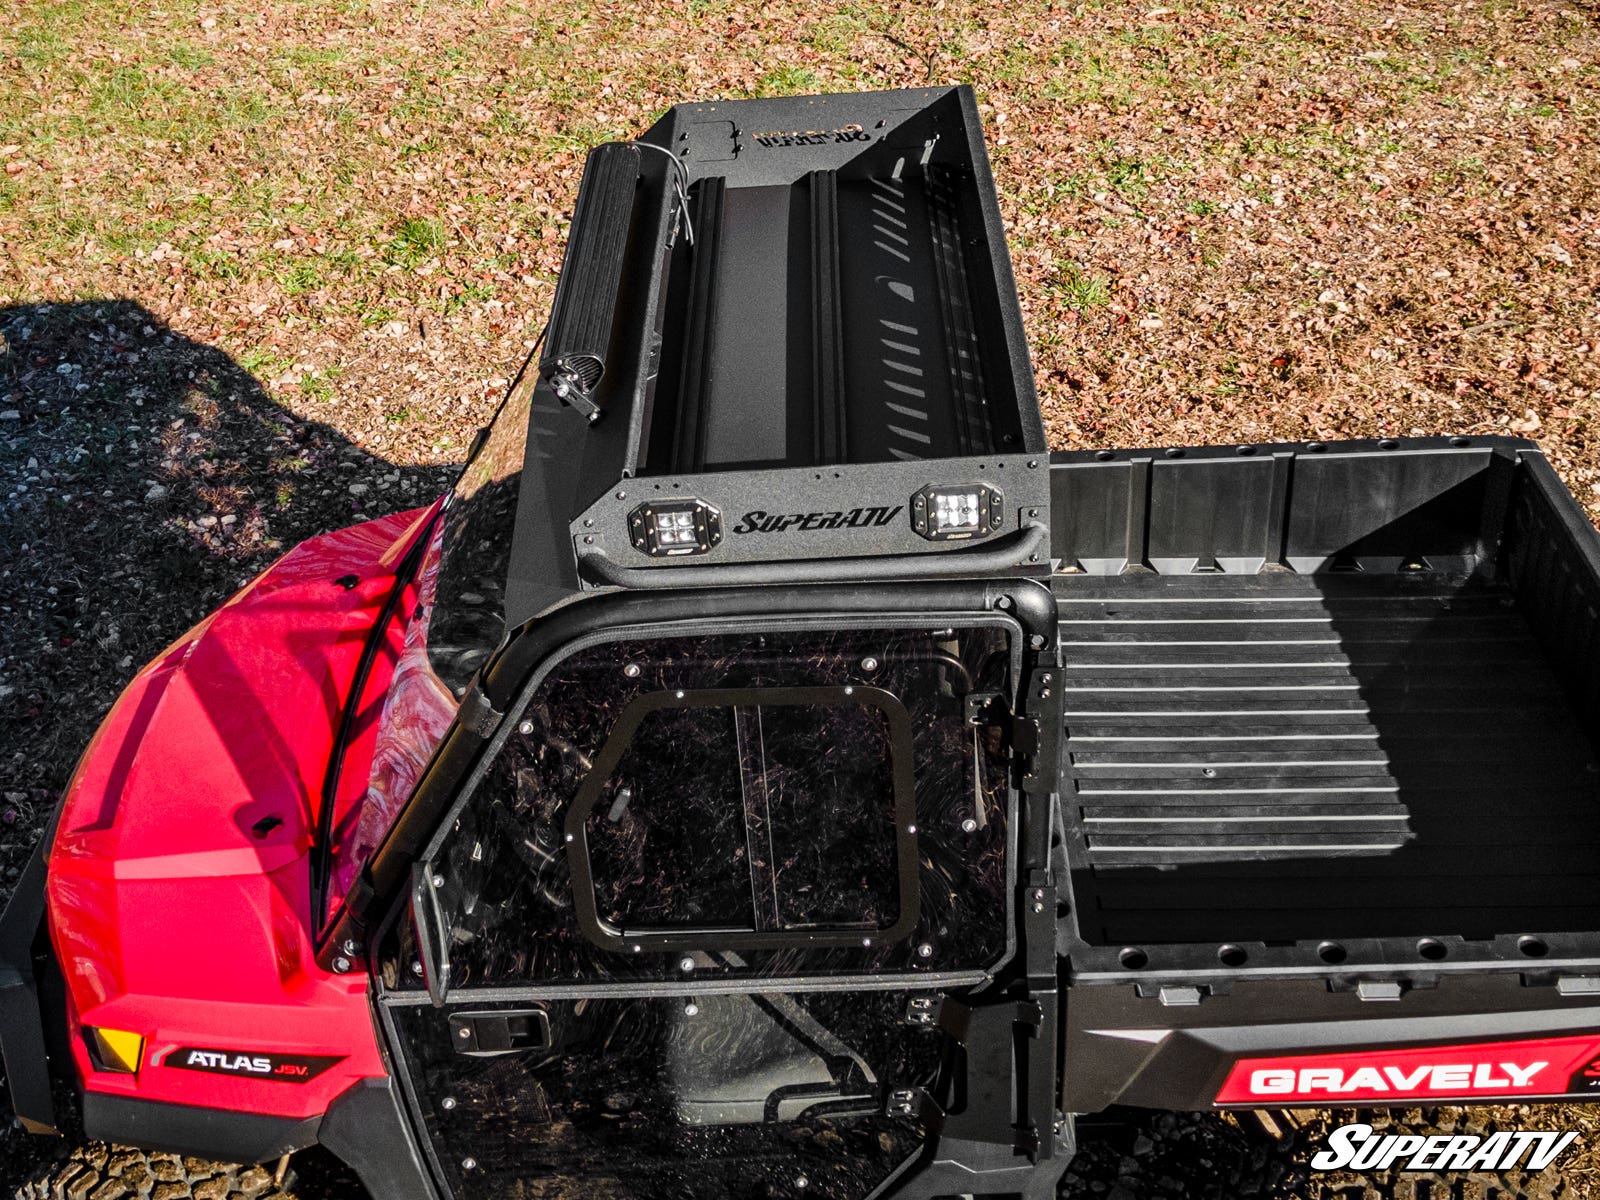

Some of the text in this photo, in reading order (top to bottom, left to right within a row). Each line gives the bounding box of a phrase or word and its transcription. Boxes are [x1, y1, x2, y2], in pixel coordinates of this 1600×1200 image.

[187, 1050, 308, 1076] ATLAS JSV
[1250, 1062, 1549, 1095] GRAVELY
